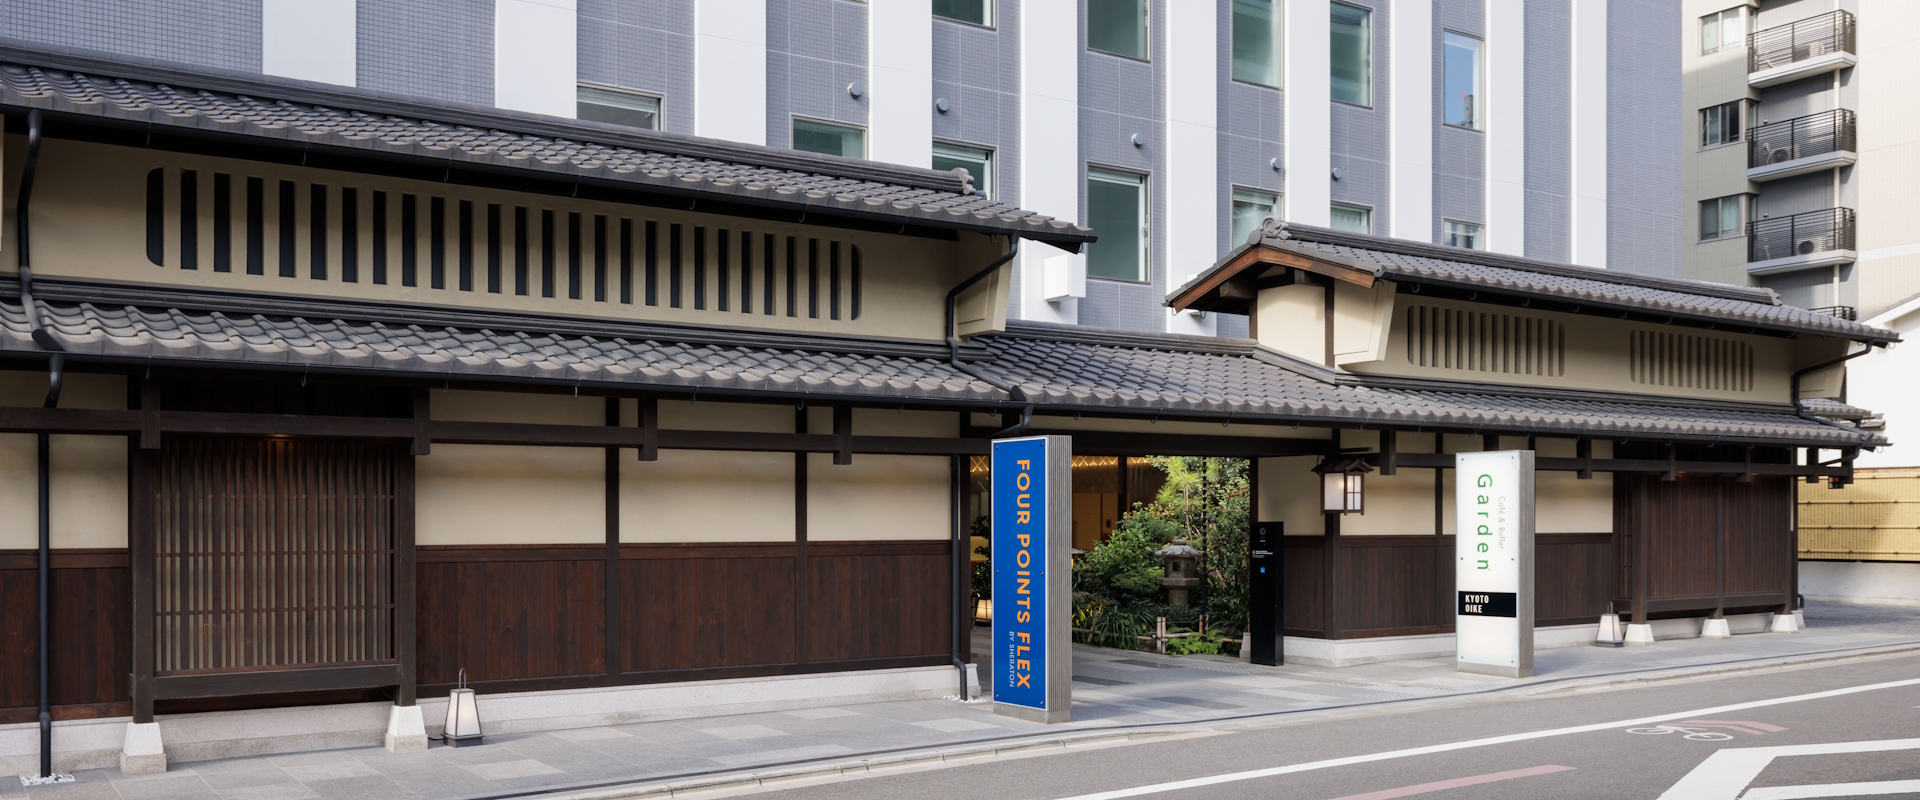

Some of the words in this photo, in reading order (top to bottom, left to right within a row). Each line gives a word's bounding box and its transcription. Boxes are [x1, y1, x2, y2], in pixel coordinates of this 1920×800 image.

[1017, 459, 1031, 525] FOUR
[1498, 496, 1506, 515] Café
[1477, 473, 1493, 570] Garden
[1498, 527, 1506, 549] Buffet
[1017, 534, 1031, 624] POINTS
[1465, 594, 1490, 604] KYOTO
[1465, 604, 1483, 613] OIKE
[1009, 631, 1015, 642] BY
[1017, 632, 1031, 689] FLEX
